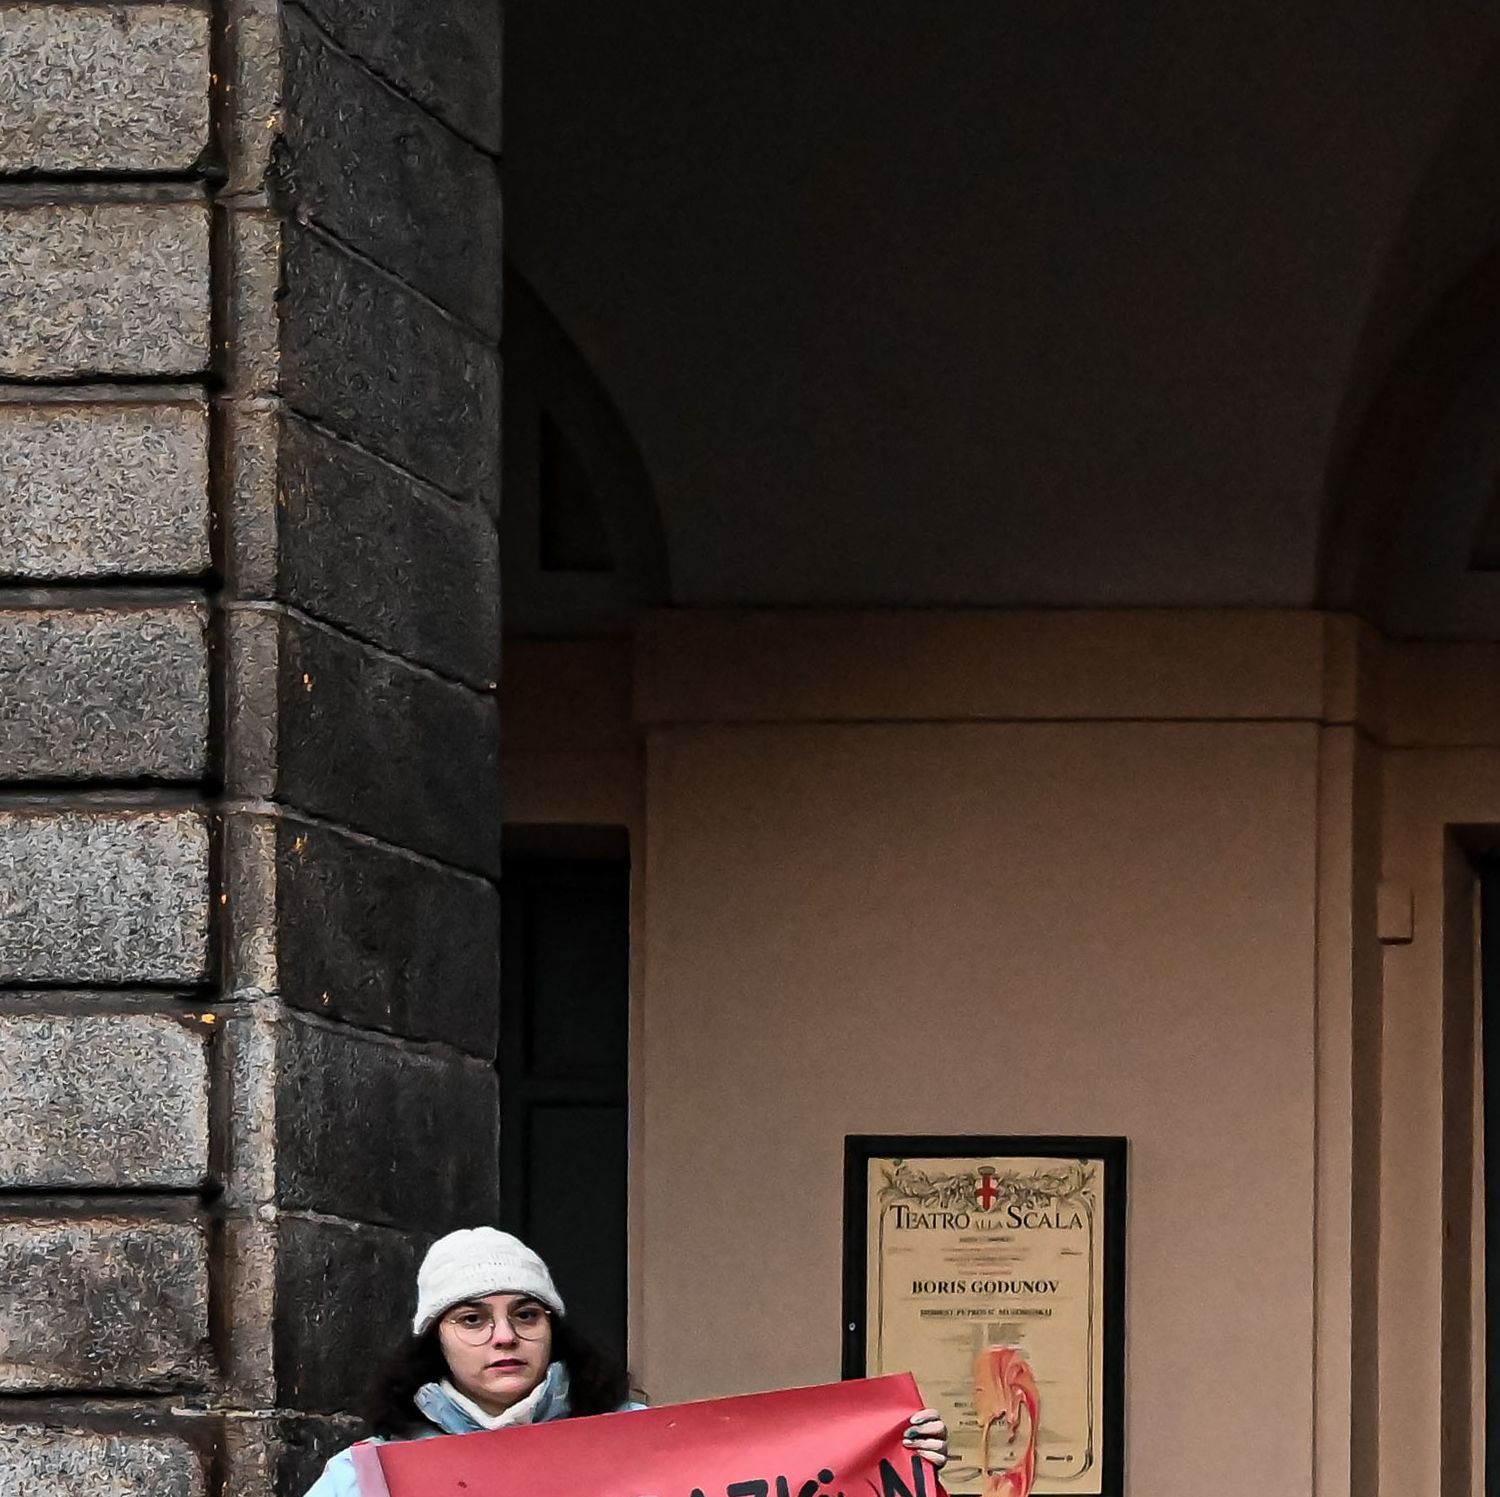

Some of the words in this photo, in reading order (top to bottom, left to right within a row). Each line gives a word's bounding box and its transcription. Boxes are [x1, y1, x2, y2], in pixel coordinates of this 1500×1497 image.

[889, 1204, 970, 1230] TEATRO
[1006, 1204, 1083, 1230] SCALA
[911, 1279, 966, 1295] BORIS
[971, 1279, 1060, 1295] GODUNOV
